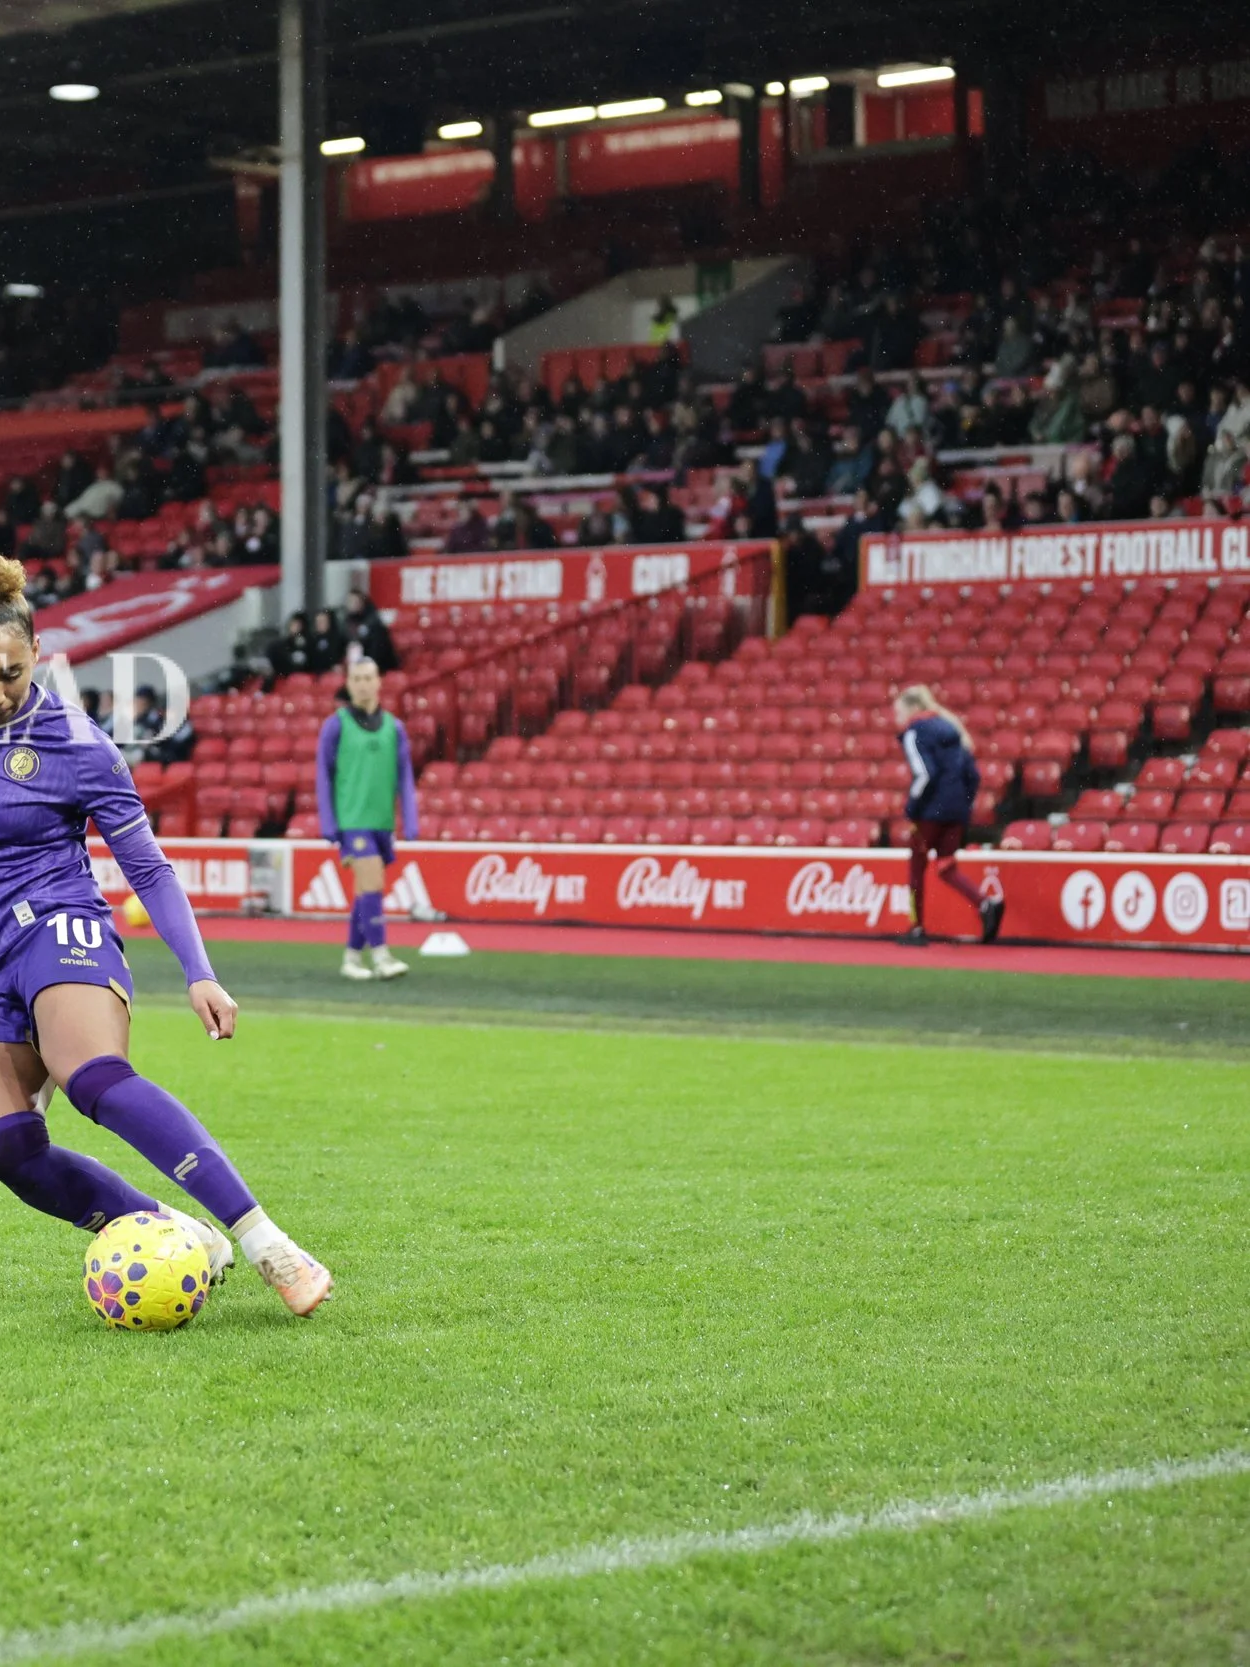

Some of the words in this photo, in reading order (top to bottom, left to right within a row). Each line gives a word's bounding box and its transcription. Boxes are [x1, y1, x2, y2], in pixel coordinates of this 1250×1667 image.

[1011, 533, 1098, 580] FOREST
[1102, 528, 1218, 576] FOOTBALL
[465, 854, 554, 915] Bally
[617, 857, 711, 920] Bally
[786, 861, 888, 927] Bally
[46, 913, 102, 948] 10
